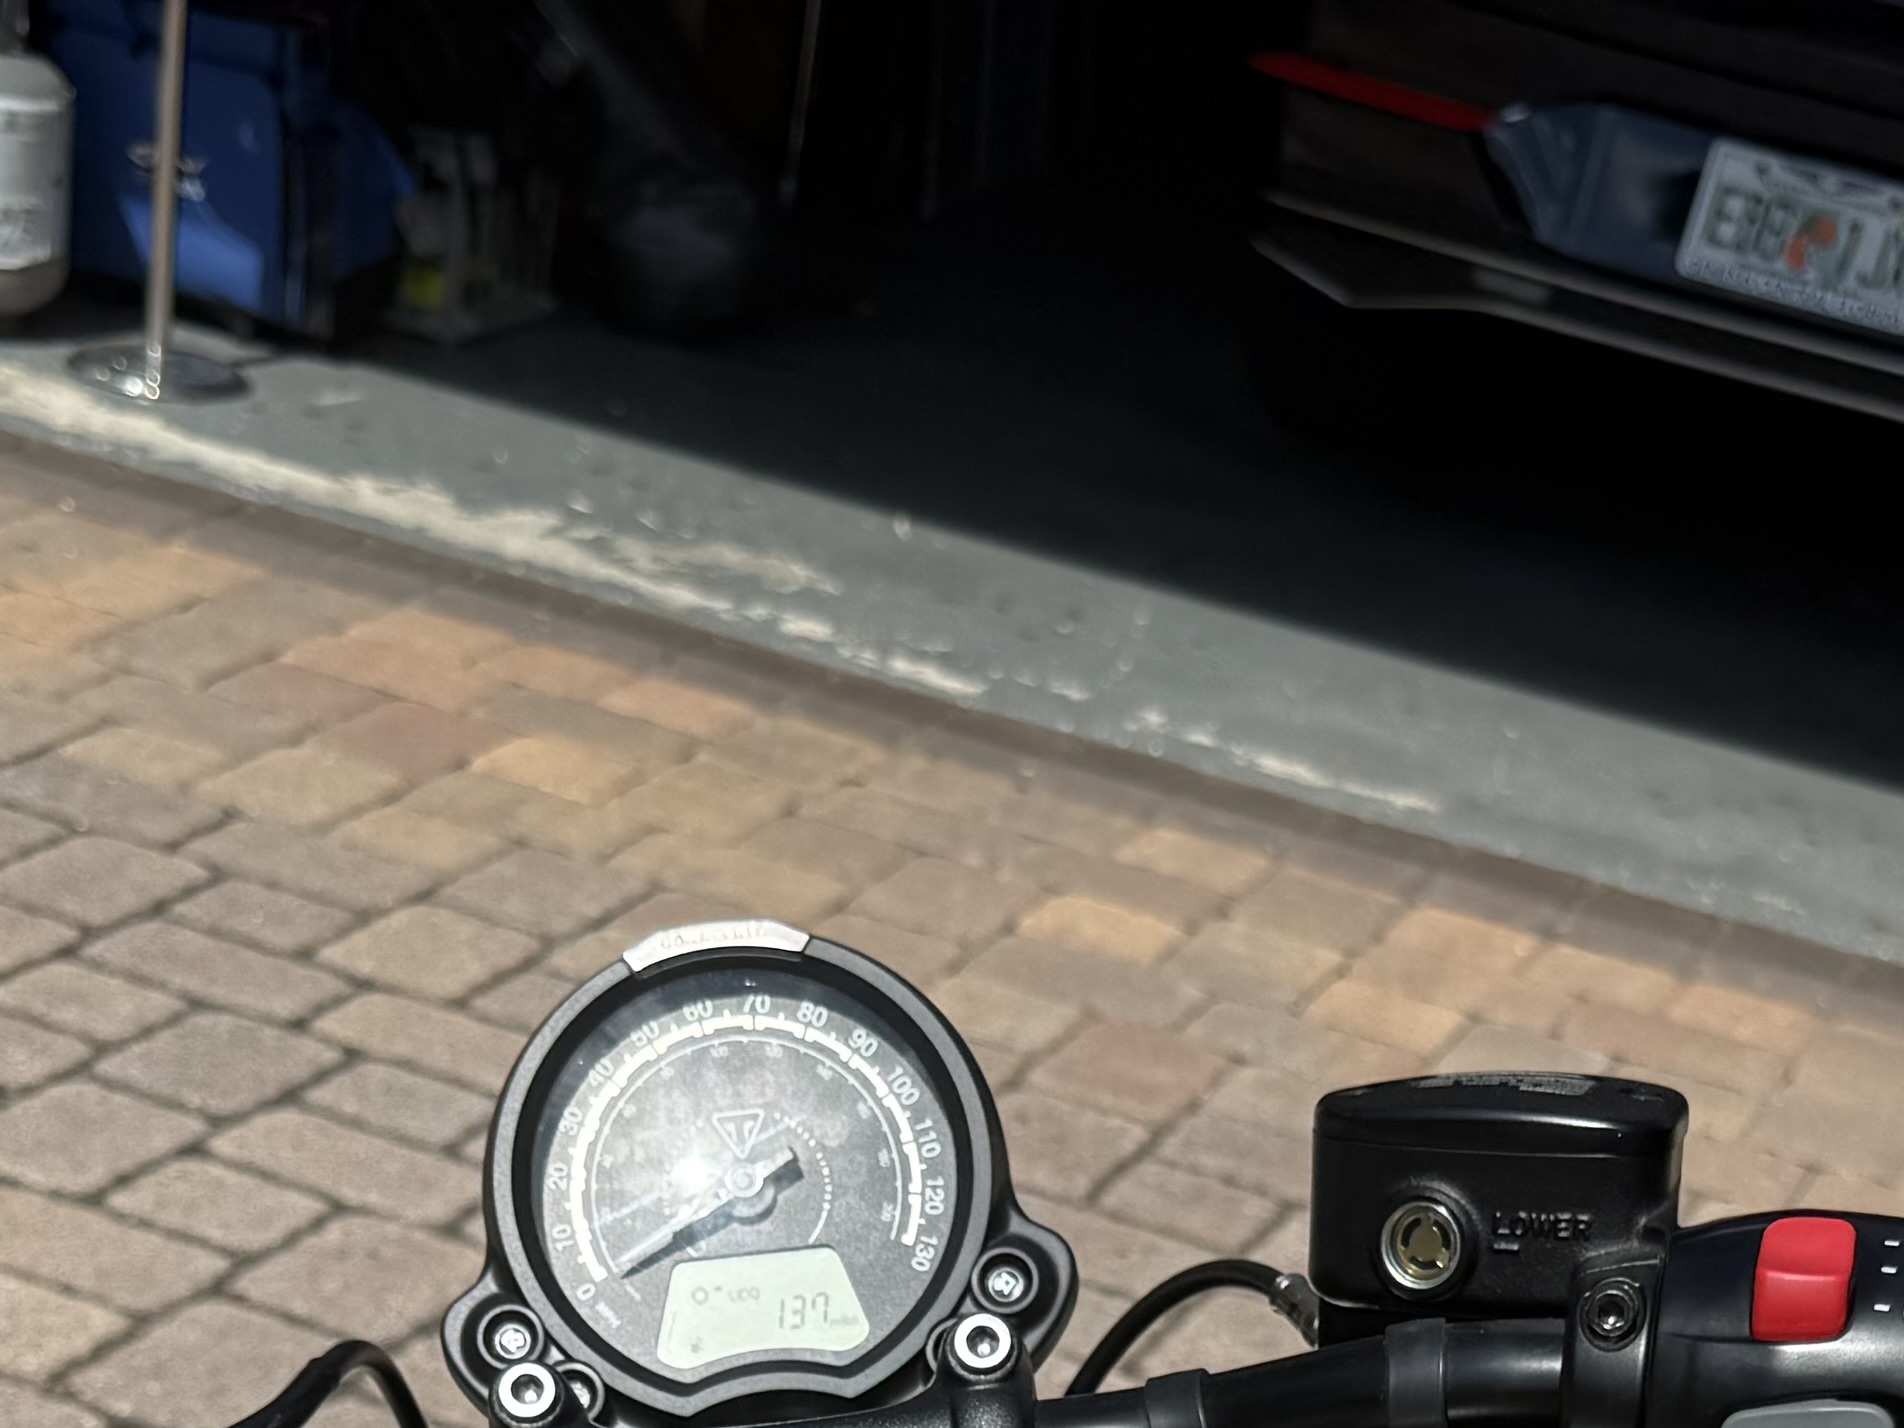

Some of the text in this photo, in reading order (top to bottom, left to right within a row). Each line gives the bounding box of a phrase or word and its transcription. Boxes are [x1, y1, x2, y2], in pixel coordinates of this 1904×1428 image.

[744, 994, 771, 1014] 70
[796, 1001, 828, 1028] 80
[848, 1028, 878, 1057] 90
[588, 1058, 614, 1087] 40
[887, 1065, 920, 1106] 100
[558, 1106, 583, 1136] 30
[915, 1118, 941, 1159] 110
[547, 1162, 568, 1191] 20
[924, 1176, 945, 1215] 120
[552, 1224, 575, 1251] 10
[1492, 1211, 1594, 1241] LOWER
[911, 1235, 938, 1272] 130
[576, 1283, 596, 1301] 0
